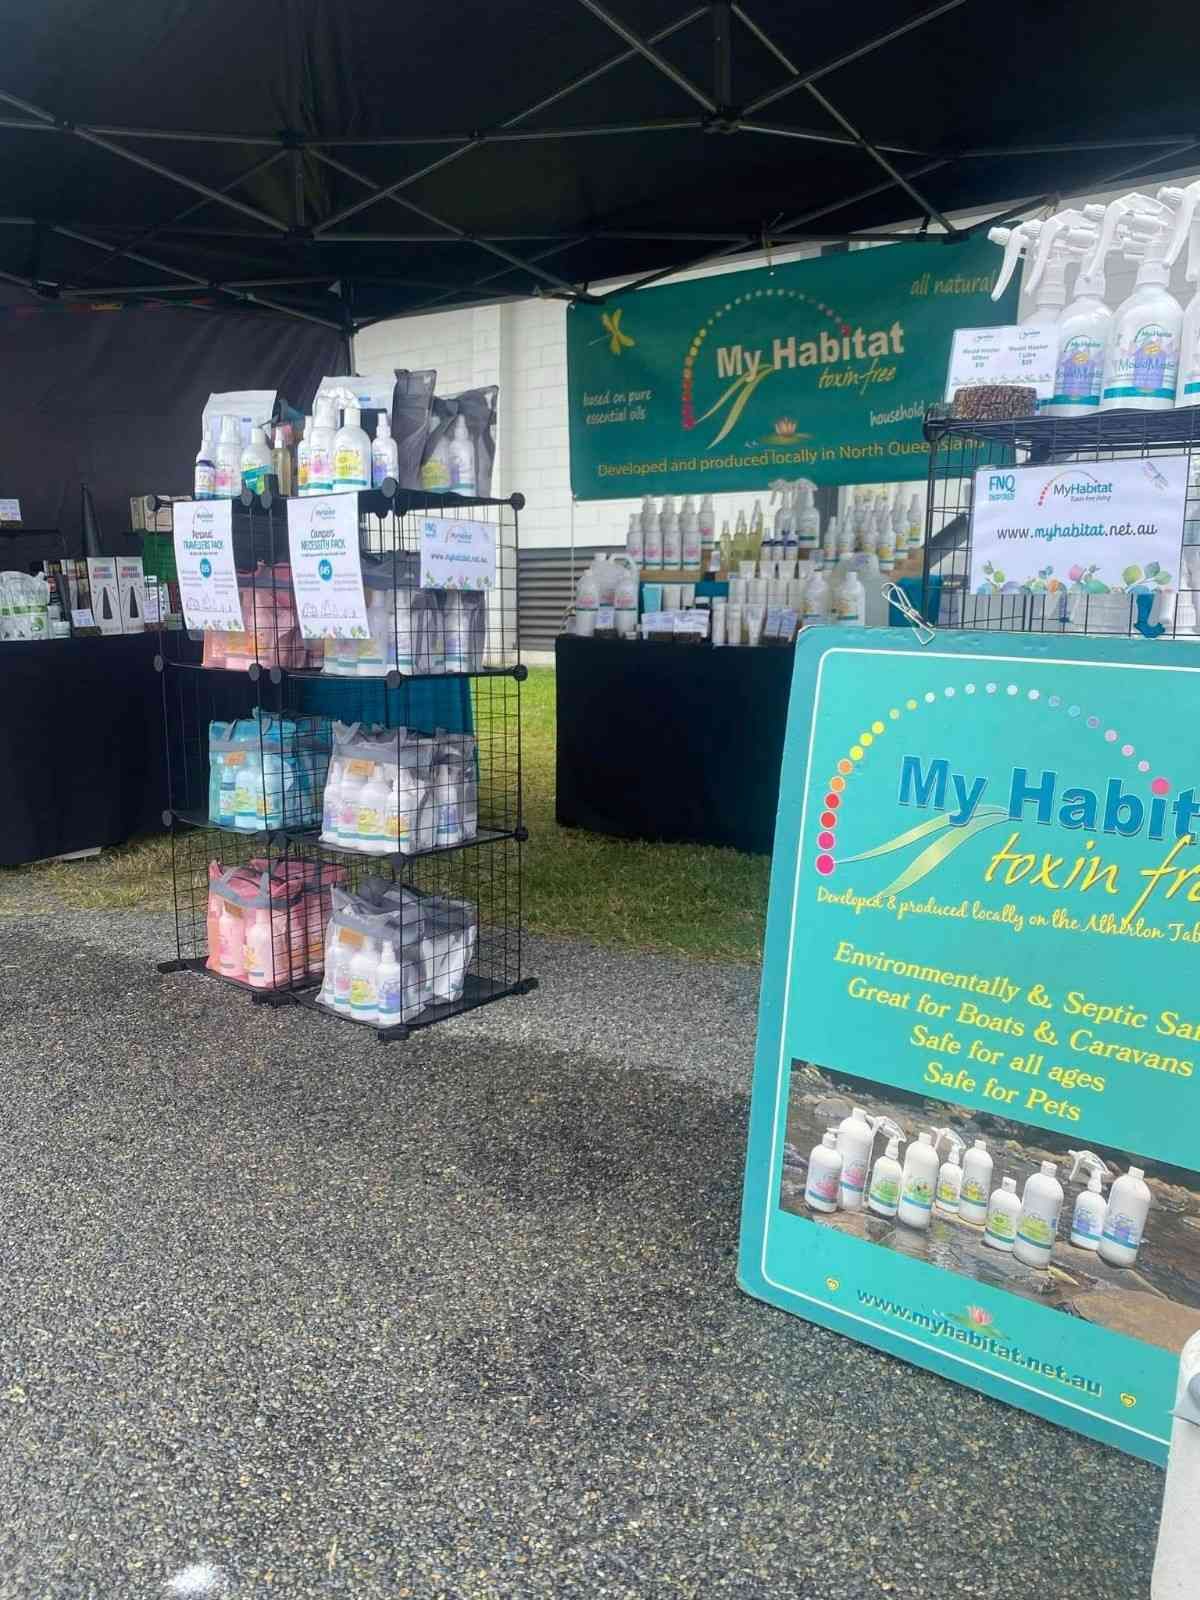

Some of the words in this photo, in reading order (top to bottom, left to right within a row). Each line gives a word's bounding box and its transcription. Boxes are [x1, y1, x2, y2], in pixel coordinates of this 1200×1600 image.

[910, 272, 930, 295] all
[934, 269, 996, 294] natural
[717, 344, 762, 382] My
[772, 320, 905, 369] Habitat
[583, 390, 611, 407] based
[612, 392, 626, 404] on
[628, 389, 653, 406] pure
[818, 359, 897, 396] toxin-free
[585, 406, 627, 425] essential
[630, 405, 647, 421] oils
[869, 400, 925, 428] household
[598, 457, 667, 477] Developed
[671, 456, 696, 471] and
[700, 452, 769, 473] produced
[772, 446, 817, 465] locally
[822, 446, 835, 460] in
[840, 440, 883, 460] North
[988, 475, 1016, 492] FNQ
[1053, 481, 1113, 498] MyHabitat
[996, 521, 1158, 542] www.myhabitat.net.au
[897, 755, 988, 827] My
[984, 832, 1120, 894] toxin
[817, 885, 883, 915] Developed
[887, 895, 897, 910] &
[897, 896, 968, 920] produced
[972, 900, 1024, 932] locally
[1029, 914, 1049, 926] on
[1051, 908, 1081, 930] the
[833, 941, 1022, 1003] Environmentally
[1027, 983, 1053, 1009] &
[1063, 991, 1148, 1029] Septic
[848, 976, 911, 1009] Great
[916, 993, 951, 1019] for
[955, 1001, 1026, 1037] Boats
[1033, 1020, 1059, 1046] &
[1070, 1028, 1194, 1078] Caravans
[910, 1024, 962, 1055] Safe
[967, 1039, 1005, 1065] for
[1009, 1053, 1044, 1076] all
[1047, 1065, 1106, 1093] ages
[923, 1061, 976, 1093] Safe
[982, 1077, 1020, 1105] for
[1024, 1087, 1082, 1122] Pets
[857, 1288, 1104, 1397] www.myhabitat.net.au
